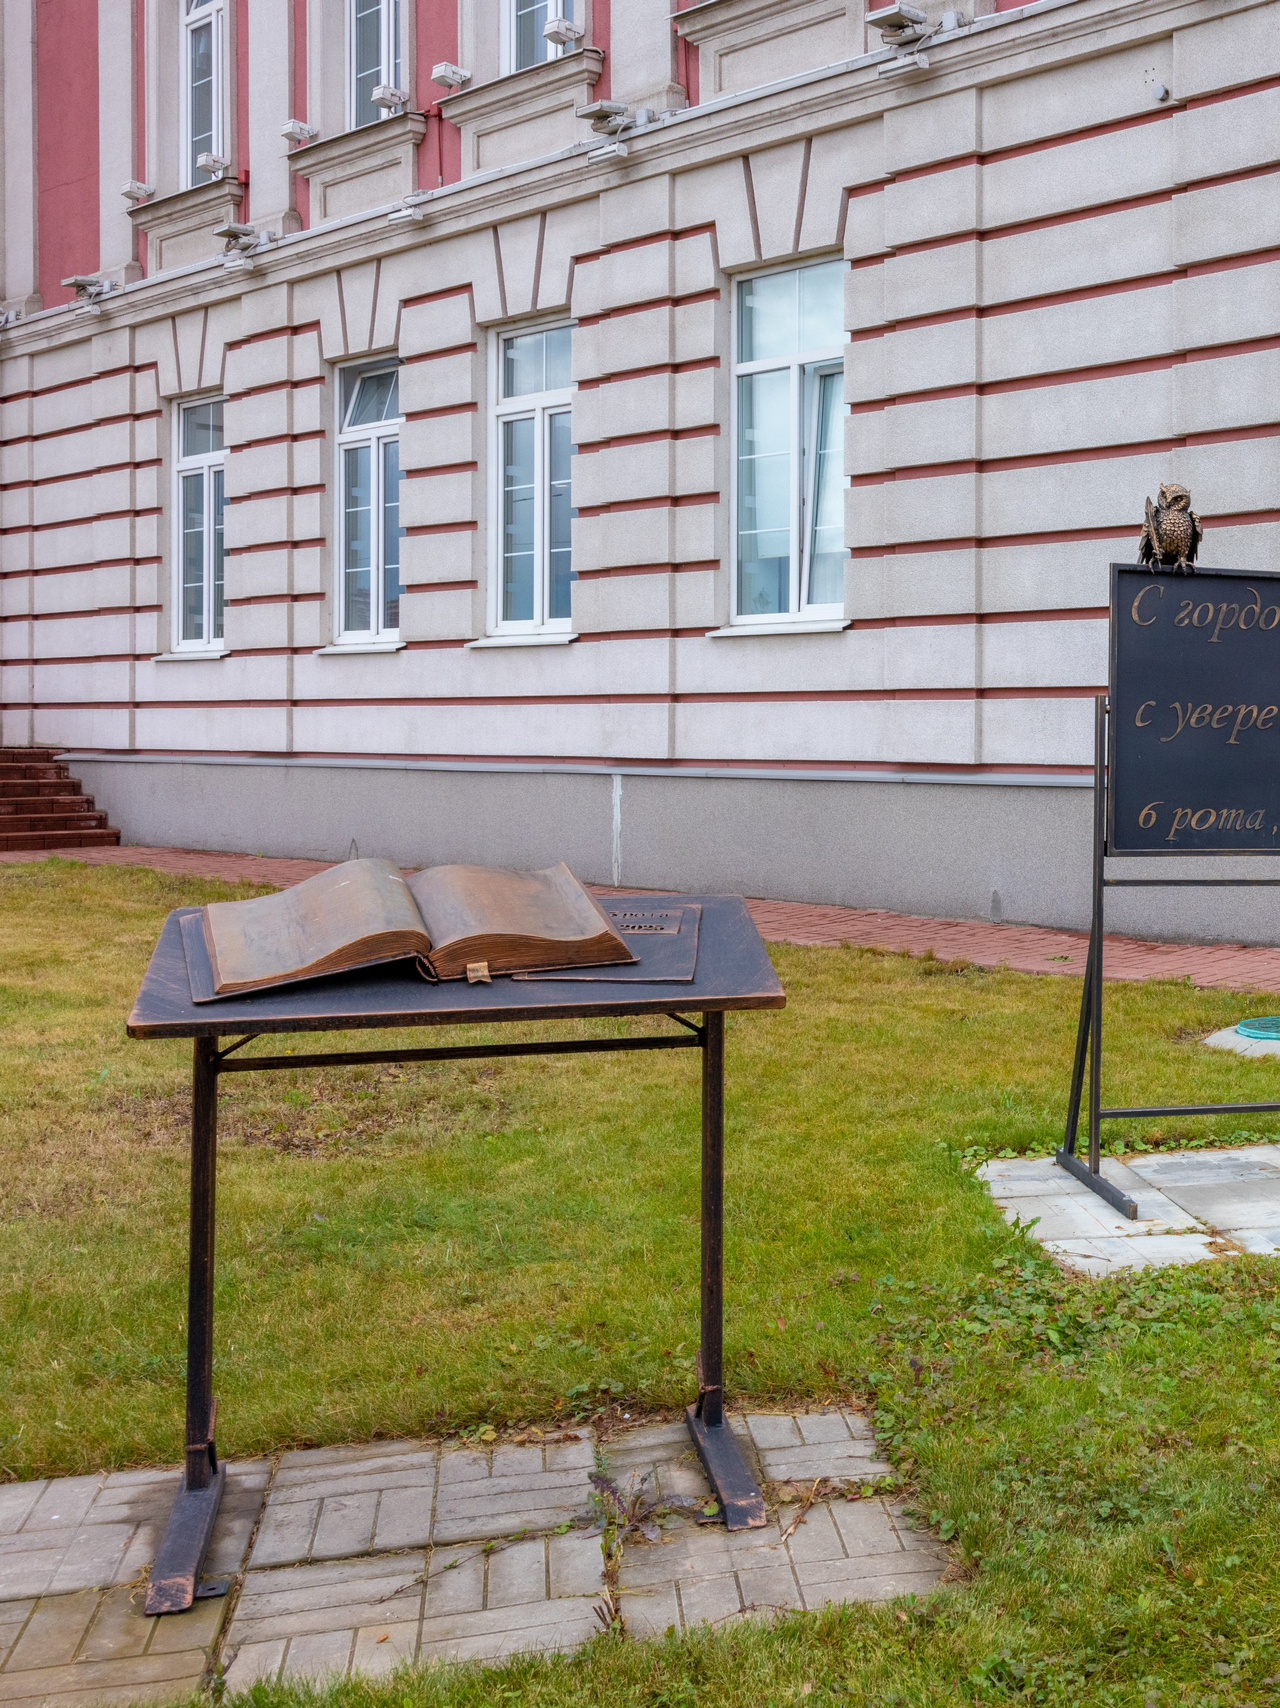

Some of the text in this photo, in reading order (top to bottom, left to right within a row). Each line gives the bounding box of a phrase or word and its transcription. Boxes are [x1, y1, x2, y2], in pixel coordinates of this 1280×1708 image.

[1131, 584, 1165, 627] С
[1135, 700, 1157, 727] с
[1138, 801, 1165, 829] 6
